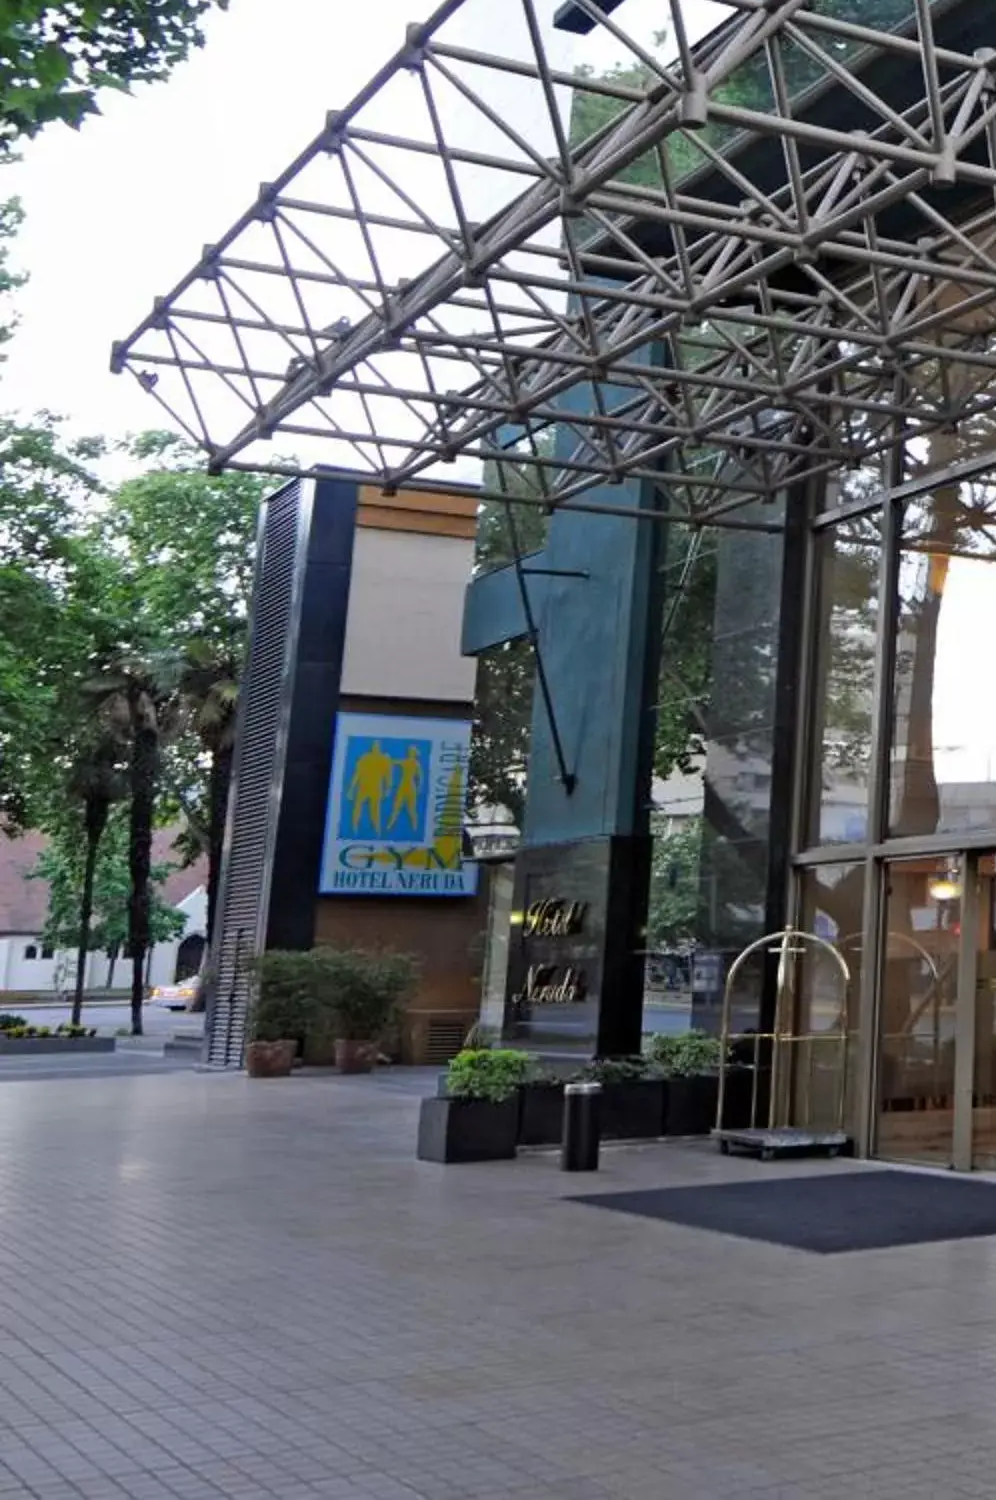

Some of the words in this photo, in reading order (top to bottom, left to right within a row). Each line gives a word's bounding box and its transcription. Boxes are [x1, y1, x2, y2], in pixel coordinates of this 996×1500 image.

[338, 844, 465, 871] GYM
[333, 870, 392, 889] HOTEL
[395, 873, 465, 891] NERUDA
[523, 897, 576, 937] Hotel
